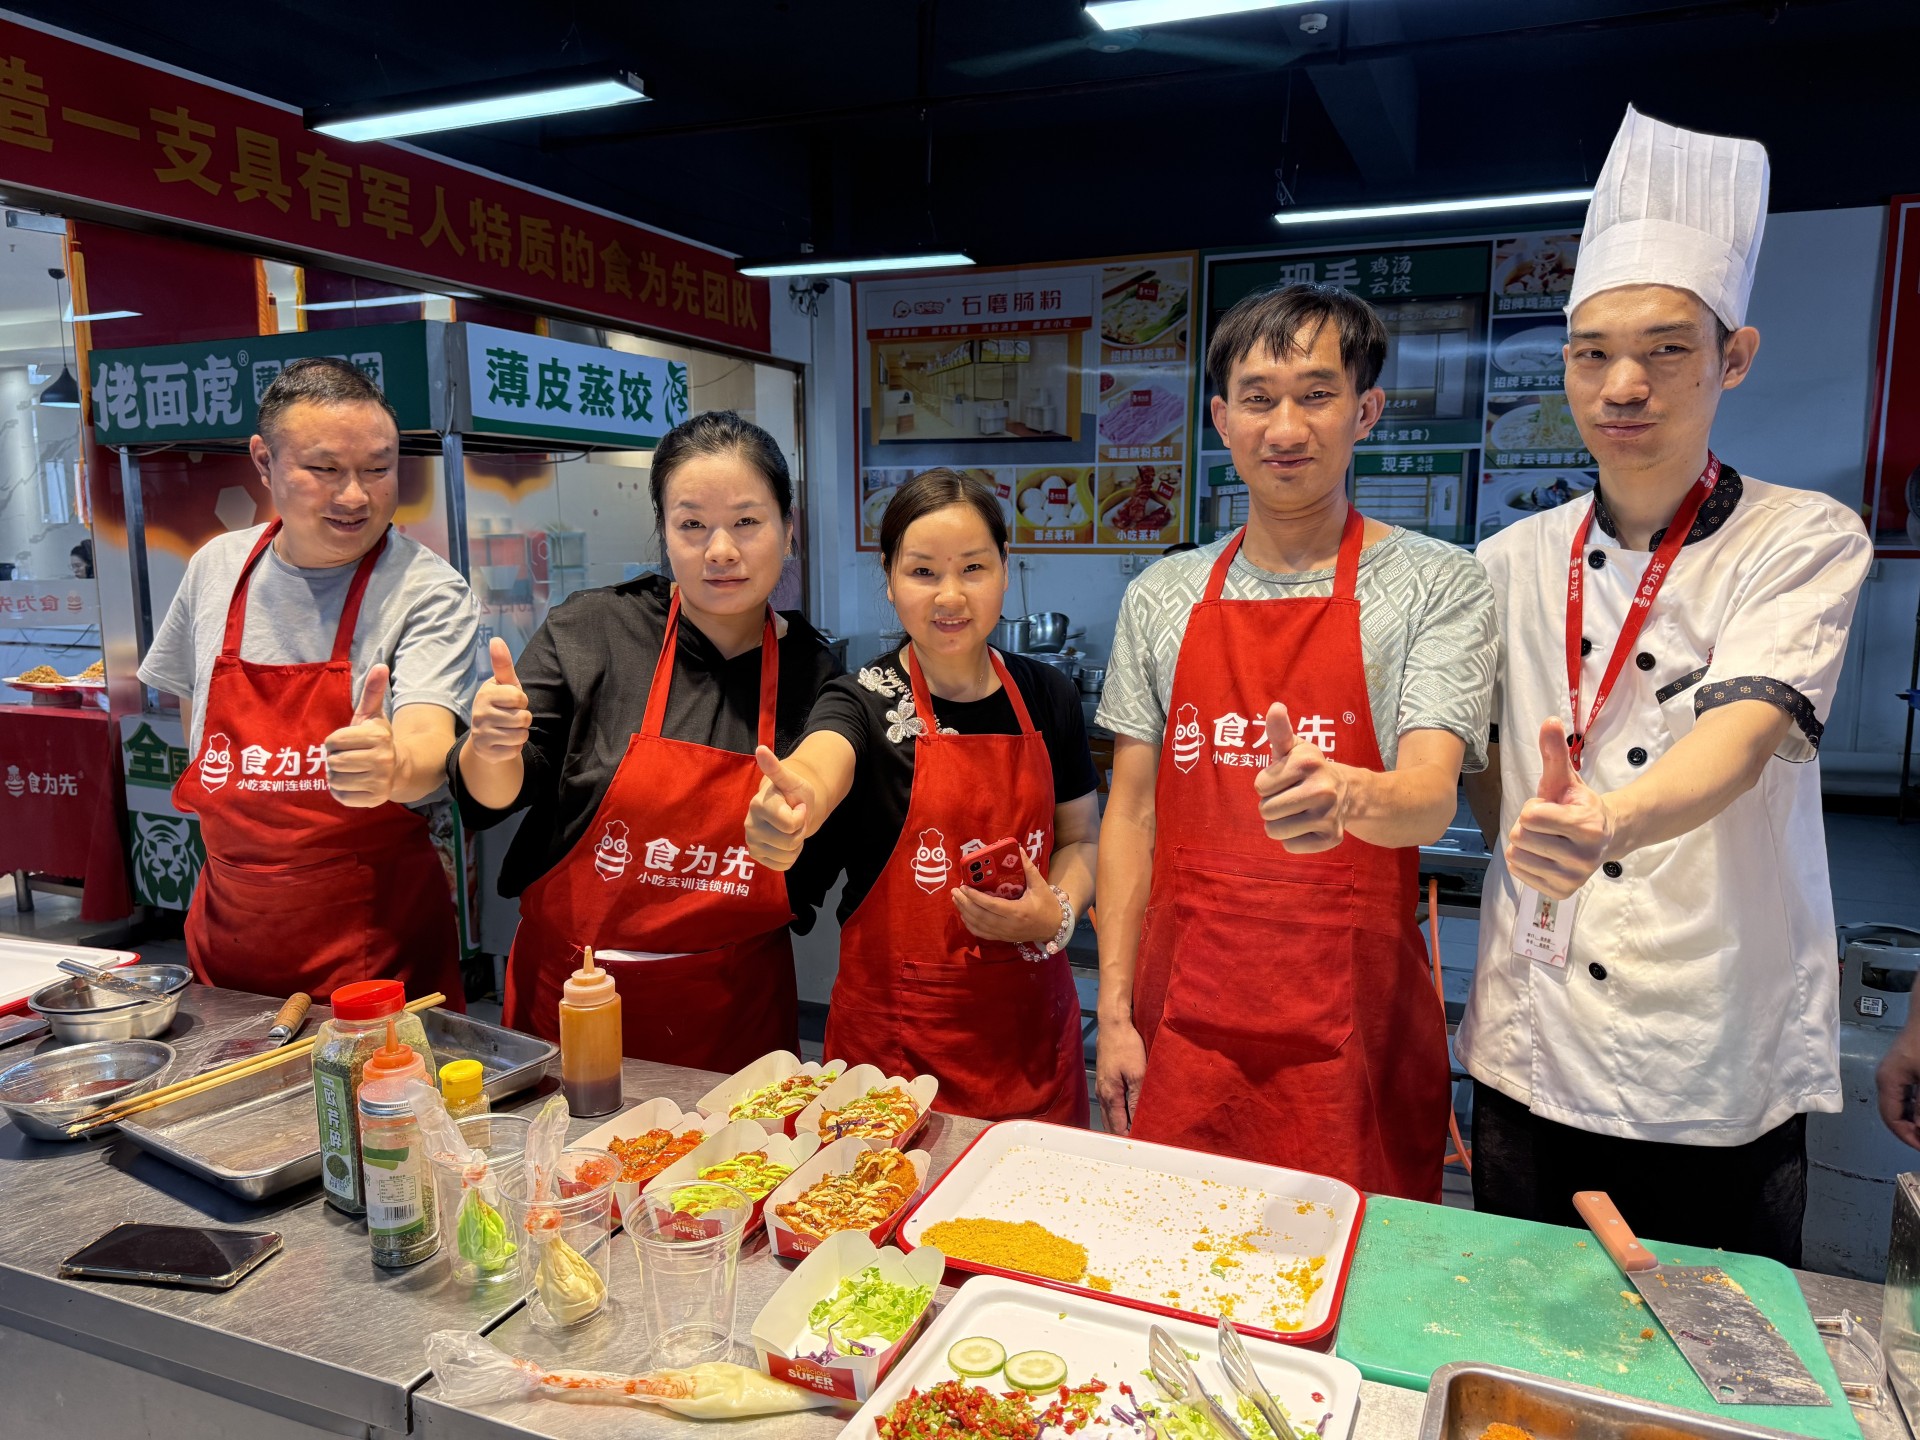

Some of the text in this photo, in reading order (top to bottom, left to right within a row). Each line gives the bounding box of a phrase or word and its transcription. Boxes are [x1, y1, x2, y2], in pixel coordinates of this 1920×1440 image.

[0, 56, 758, 331] 造一支具有军人特质的食为先团队
[1369, 255, 1413, 276] 鸡汤
[1369, 276, 1413, 296] 云饺
[962, 289, 1062, 317] 石磨肠粉
[91, 354, 243, 432] 佬面虎
[485, 347, 654, 424] 薄皮蒸饺
[1381, 455, 1414, 473] 现手
[1116, 529, 1160, 542] 小吃系列
[1642, 561, 1666, 597] 食为先
[28, 772, 79, 797] 食为先
[644, 837, 755, 881] 食为先
[636, 871, 750, 897] 小吃实训连锁机构
[323, 1087, 343, 1151] 欧芹碎
[787, 1368, 834, 1388] SUPER
[796, 1364, 831, 1379] Delicious
